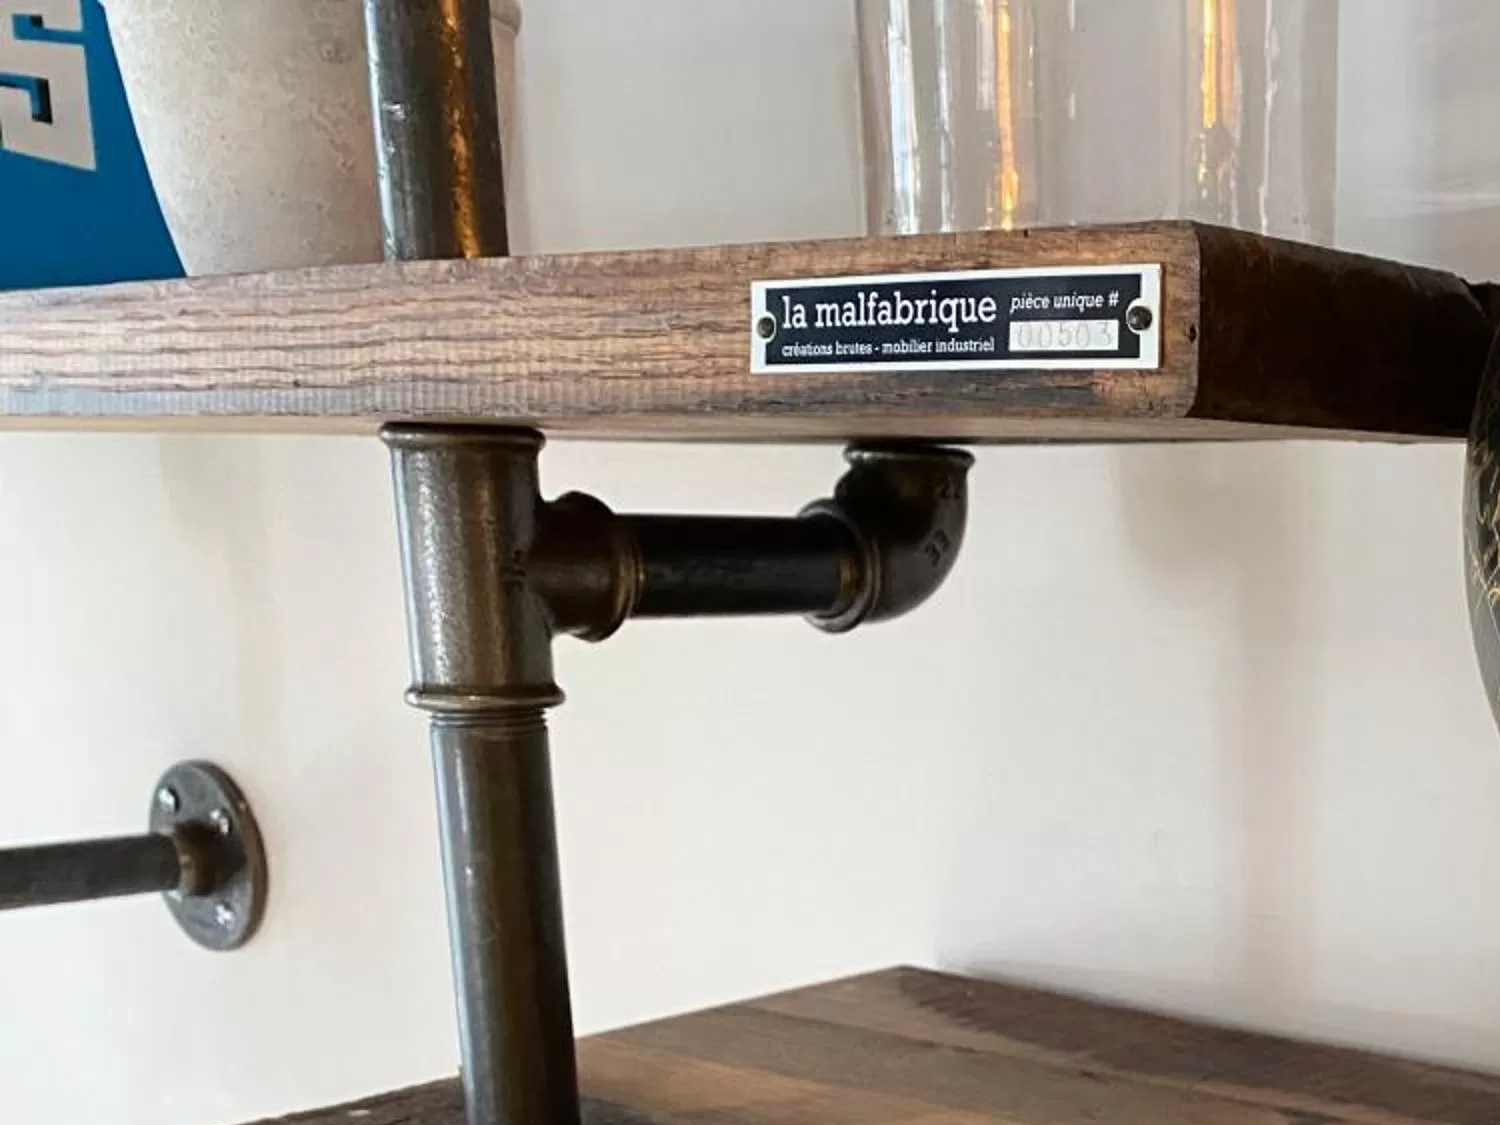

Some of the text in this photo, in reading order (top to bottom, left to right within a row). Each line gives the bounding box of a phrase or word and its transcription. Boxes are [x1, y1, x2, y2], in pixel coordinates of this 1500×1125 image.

[782, 289, 998, 333] la malfabrique
[1009, 291, 1050, 315] pièce
[1053, 291, 1104, 313] unique
[781, 341, 834, 358] créations
[835, 340, 874, 356] brutes
[881, 338, 933, 354] mobilier
[935, 336, 995, 354] industriel
